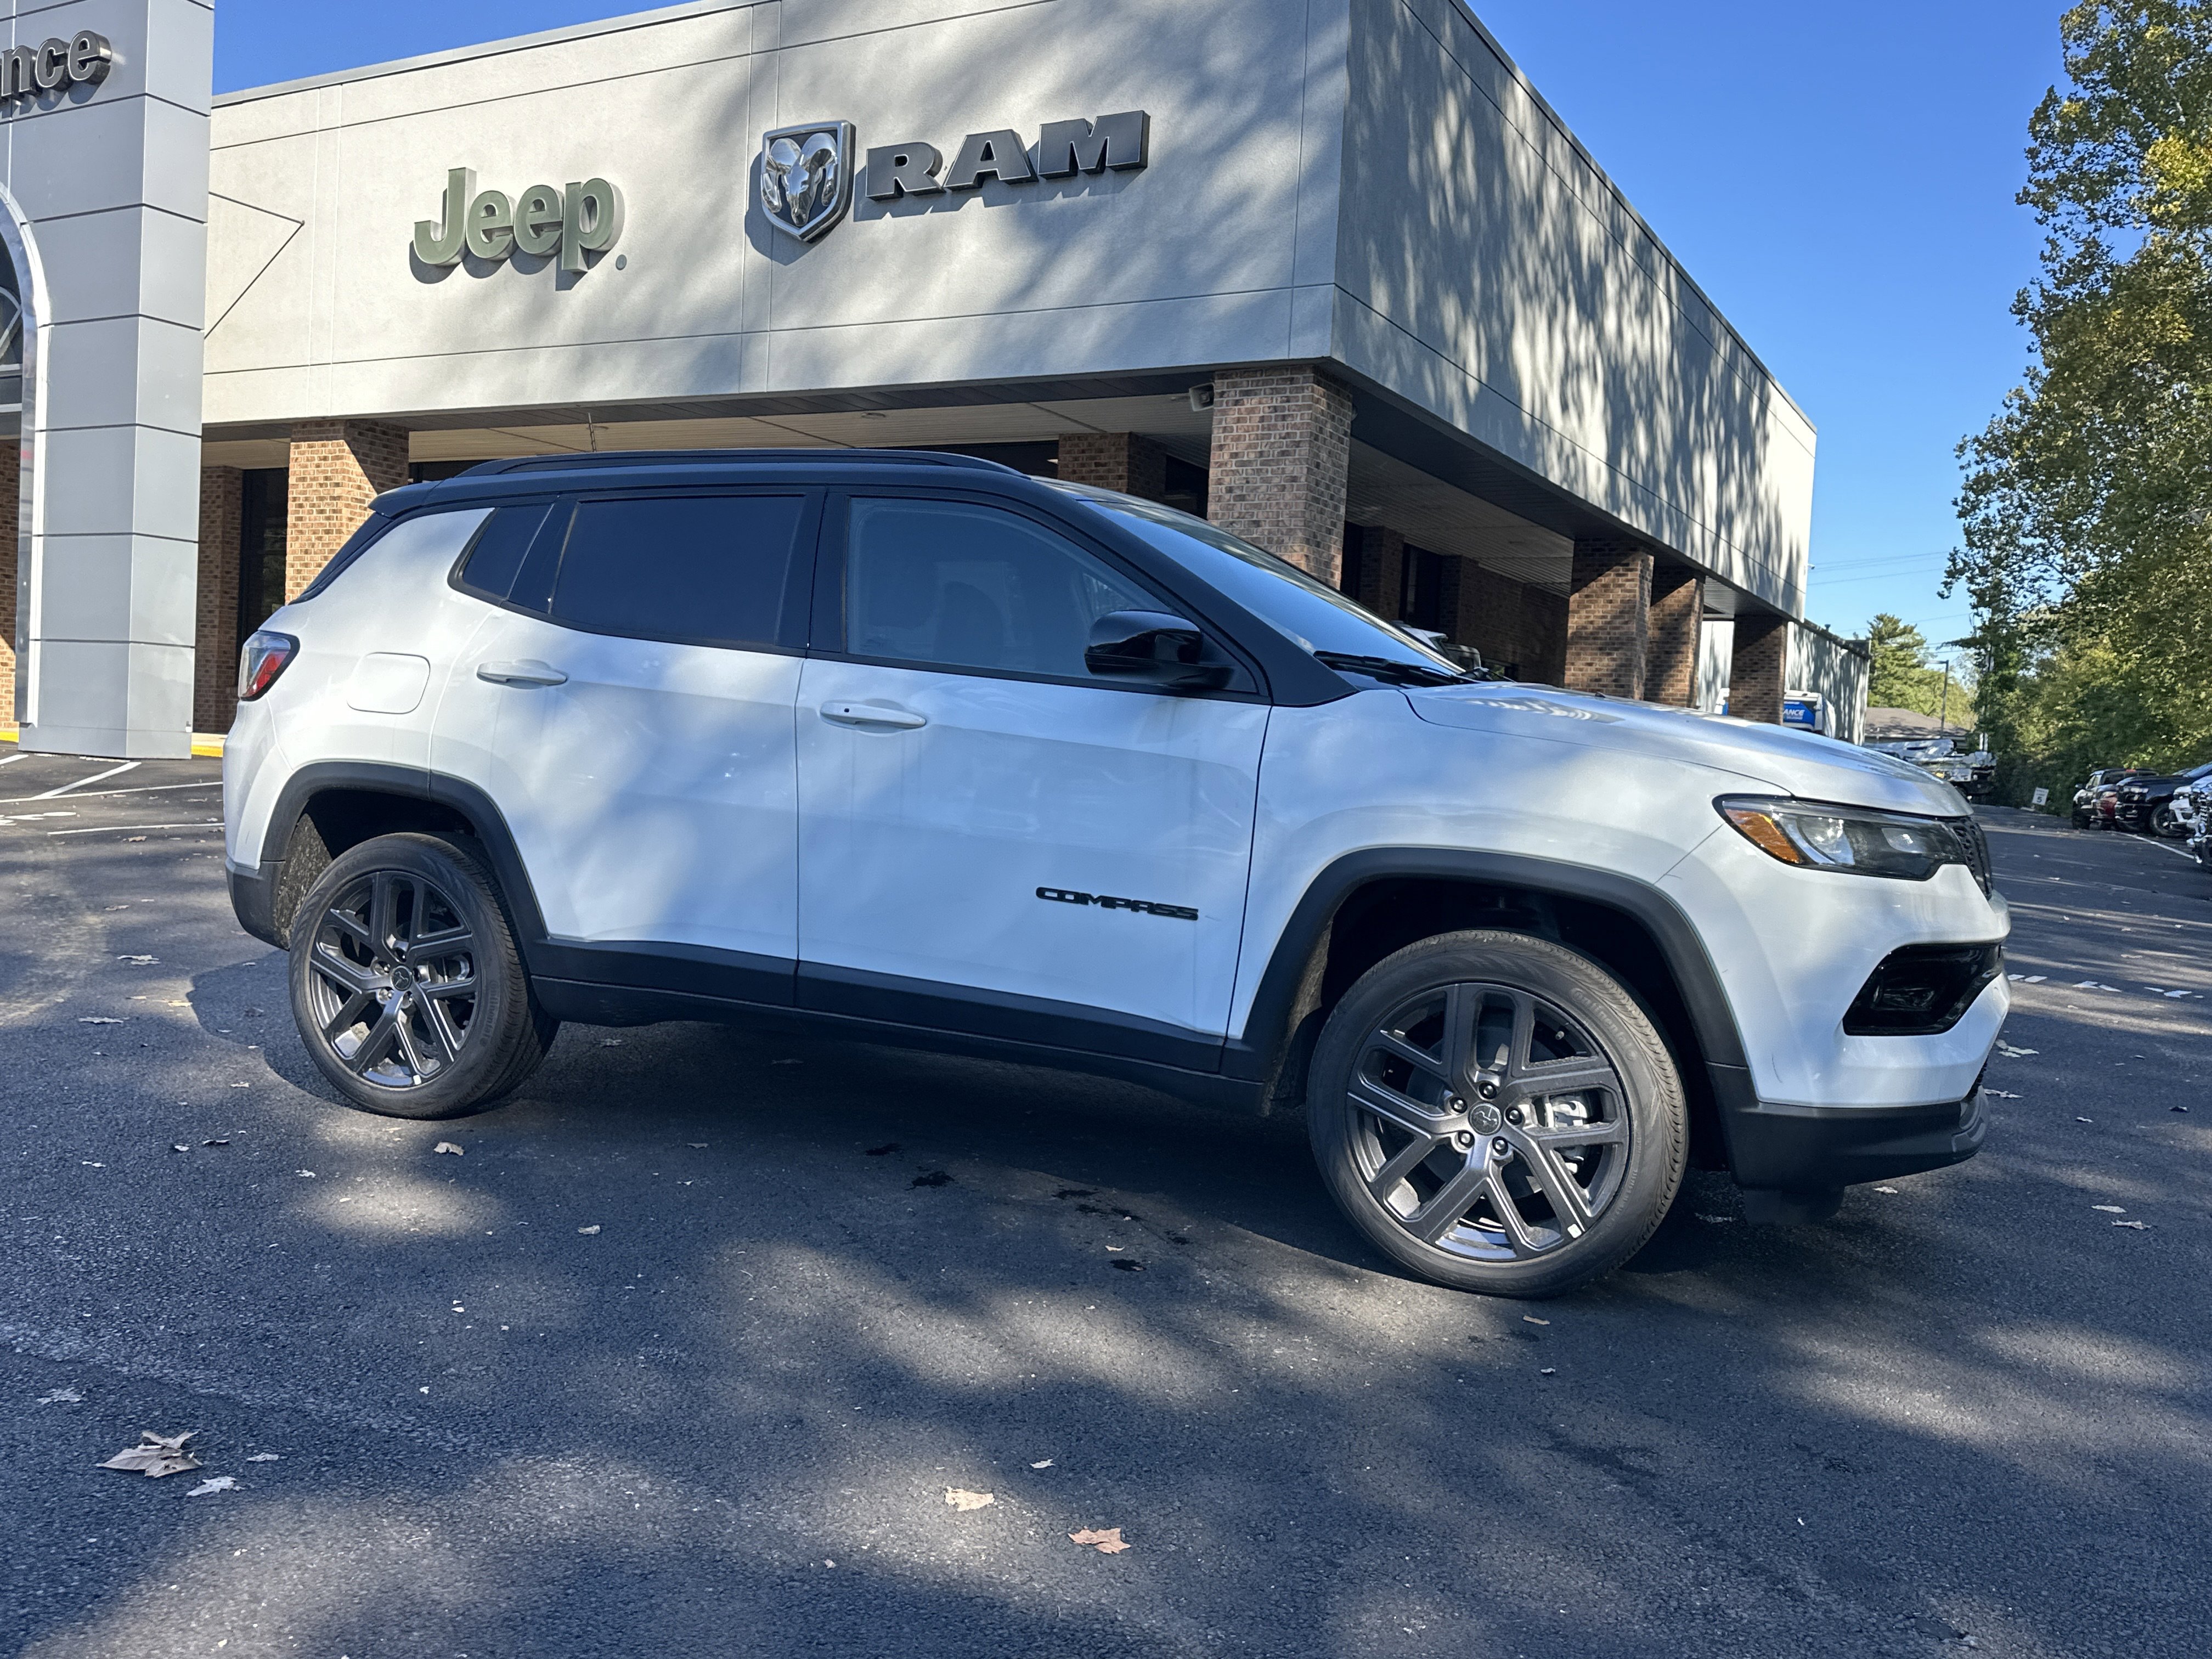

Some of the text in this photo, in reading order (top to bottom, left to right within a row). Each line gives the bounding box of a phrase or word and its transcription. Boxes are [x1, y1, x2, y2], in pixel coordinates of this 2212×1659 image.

[0, 30, 112, 100] nce
[865, 110, 1151, 201] RAM
[414, 167, 625, 273] Jeep
[1036, 887, 1199, 921] COMPASS
